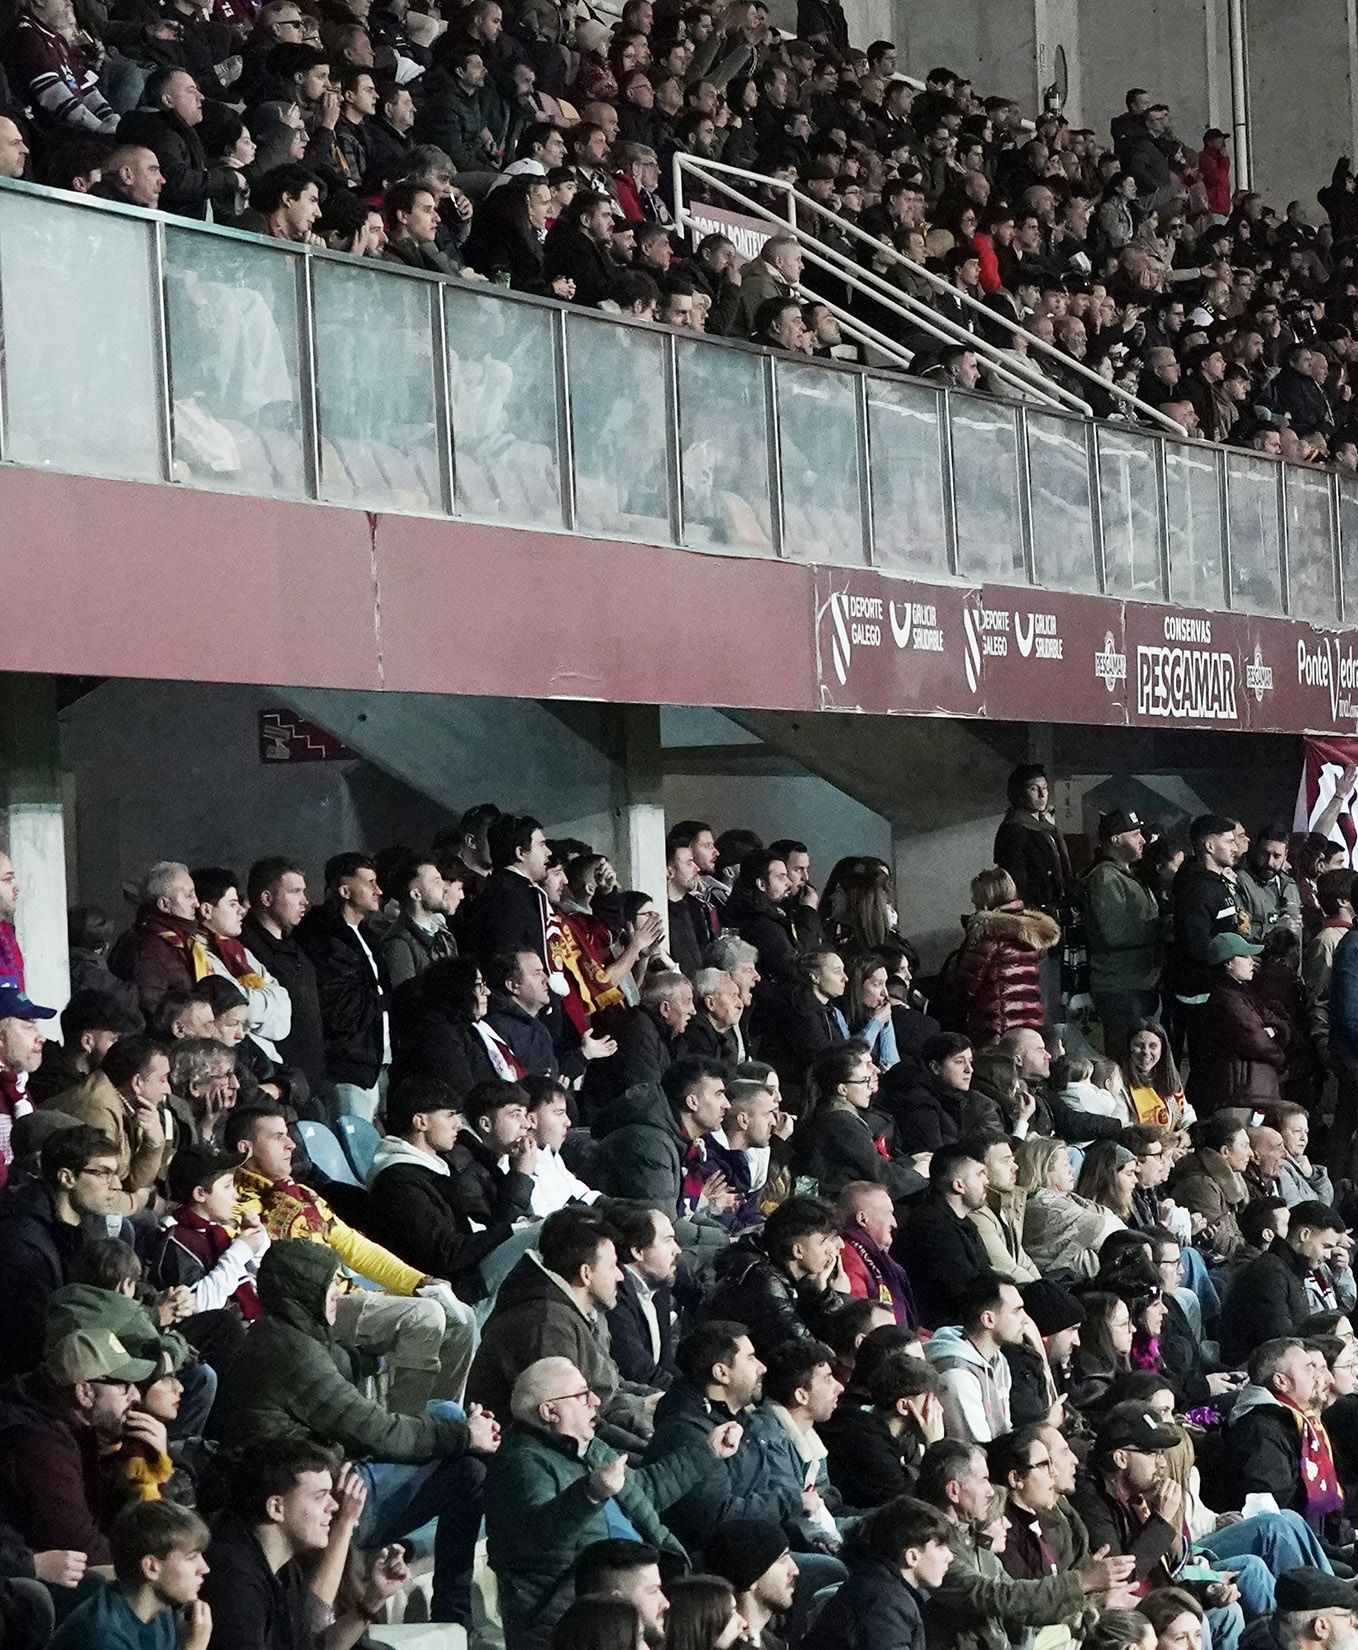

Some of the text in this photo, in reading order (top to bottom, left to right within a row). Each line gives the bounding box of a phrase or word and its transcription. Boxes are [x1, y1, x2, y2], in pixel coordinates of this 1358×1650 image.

[851, 595, 884, 620] DEPORTE
[852, 625, 881, 647] GALEGO
[1164, 616, 1211, 644] CONSERVAS
[1137, 646, 1237, 719] PESCAMAR
